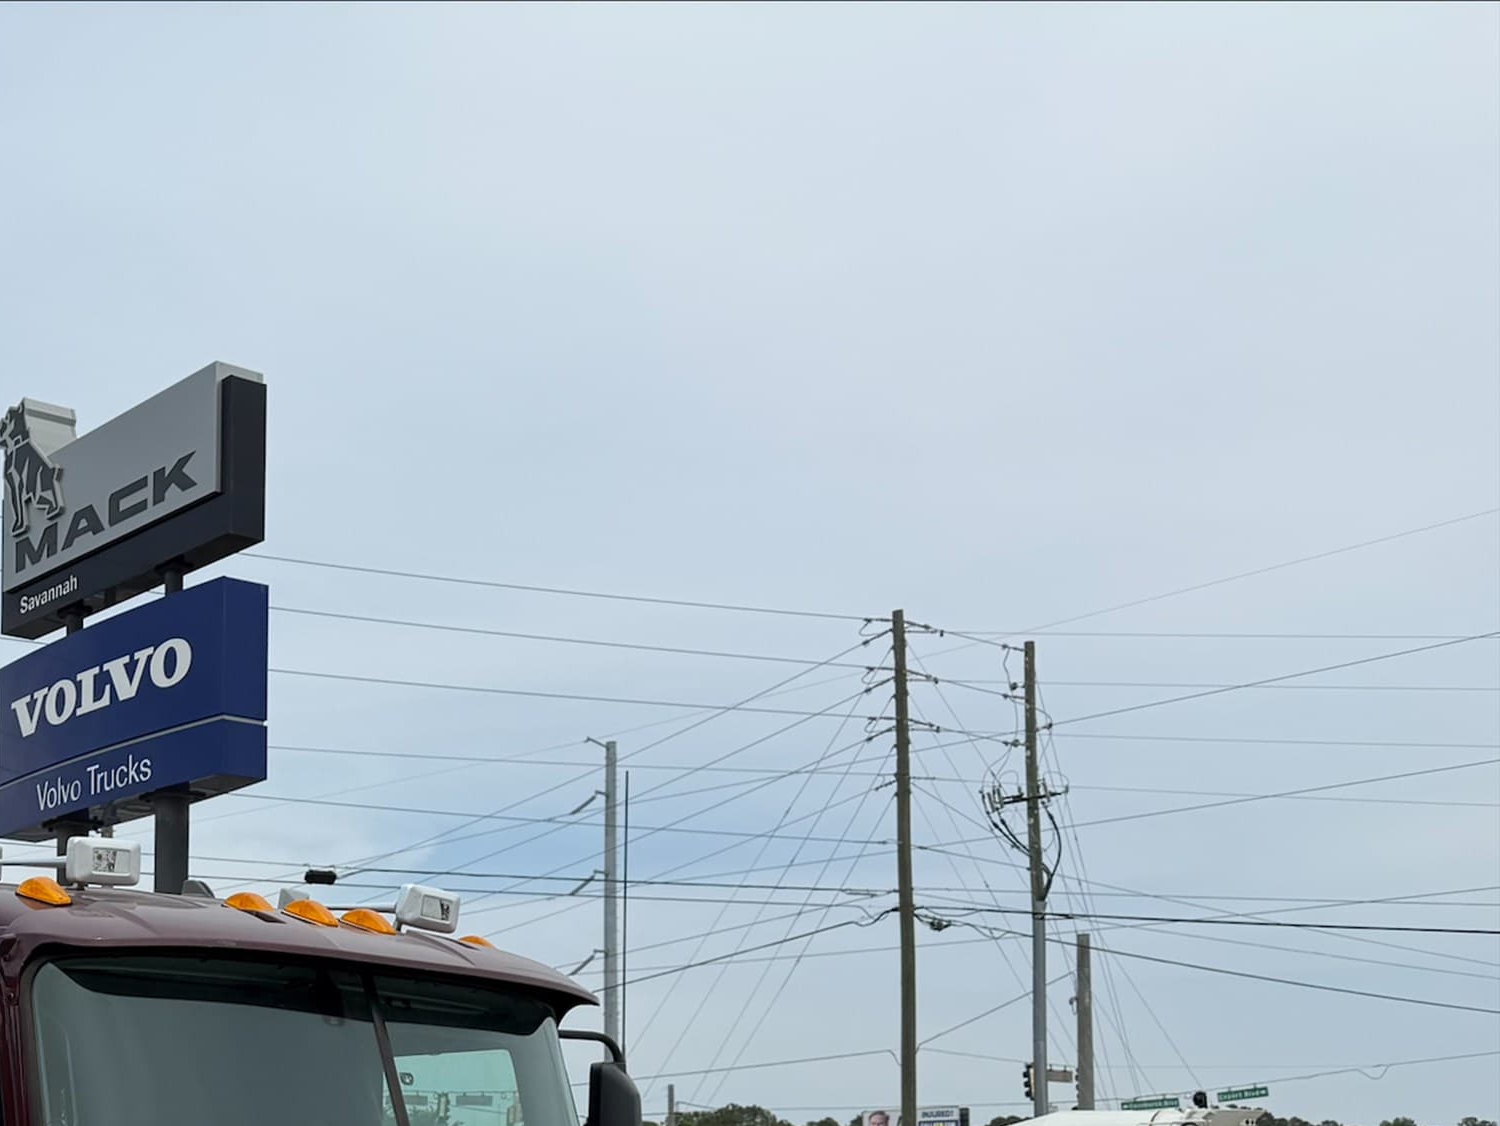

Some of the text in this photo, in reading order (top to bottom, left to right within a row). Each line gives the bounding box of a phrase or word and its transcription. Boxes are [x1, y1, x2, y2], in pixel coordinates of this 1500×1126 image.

[15, 449, 198, 573] MACK
[19, 573, 79, 615] Savannah
[11, 636, 192, 738] VOLVO
[36, 754, 153, 812] Volvo Trucks
